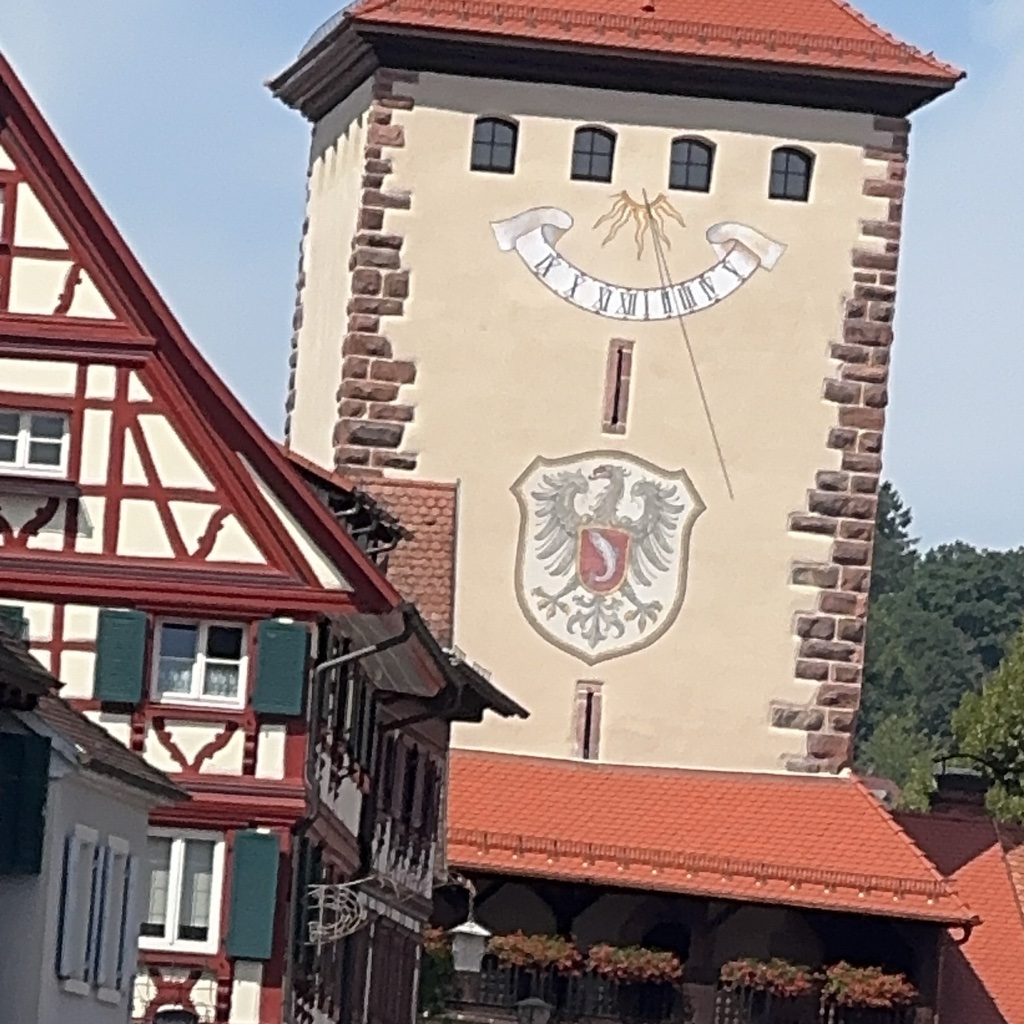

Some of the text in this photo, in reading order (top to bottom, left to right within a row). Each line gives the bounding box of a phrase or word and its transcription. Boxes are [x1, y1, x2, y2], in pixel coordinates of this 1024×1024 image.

[534, 253, 561, 278] IX
[564, 274, 587, 299] X
[592, 287, 612, 312] XI
[615, 291, 638, 316] XII
[678, 285, 698, 310] III
[699, 276, 720, 301] IV
[722, 261, 745, 281] V
